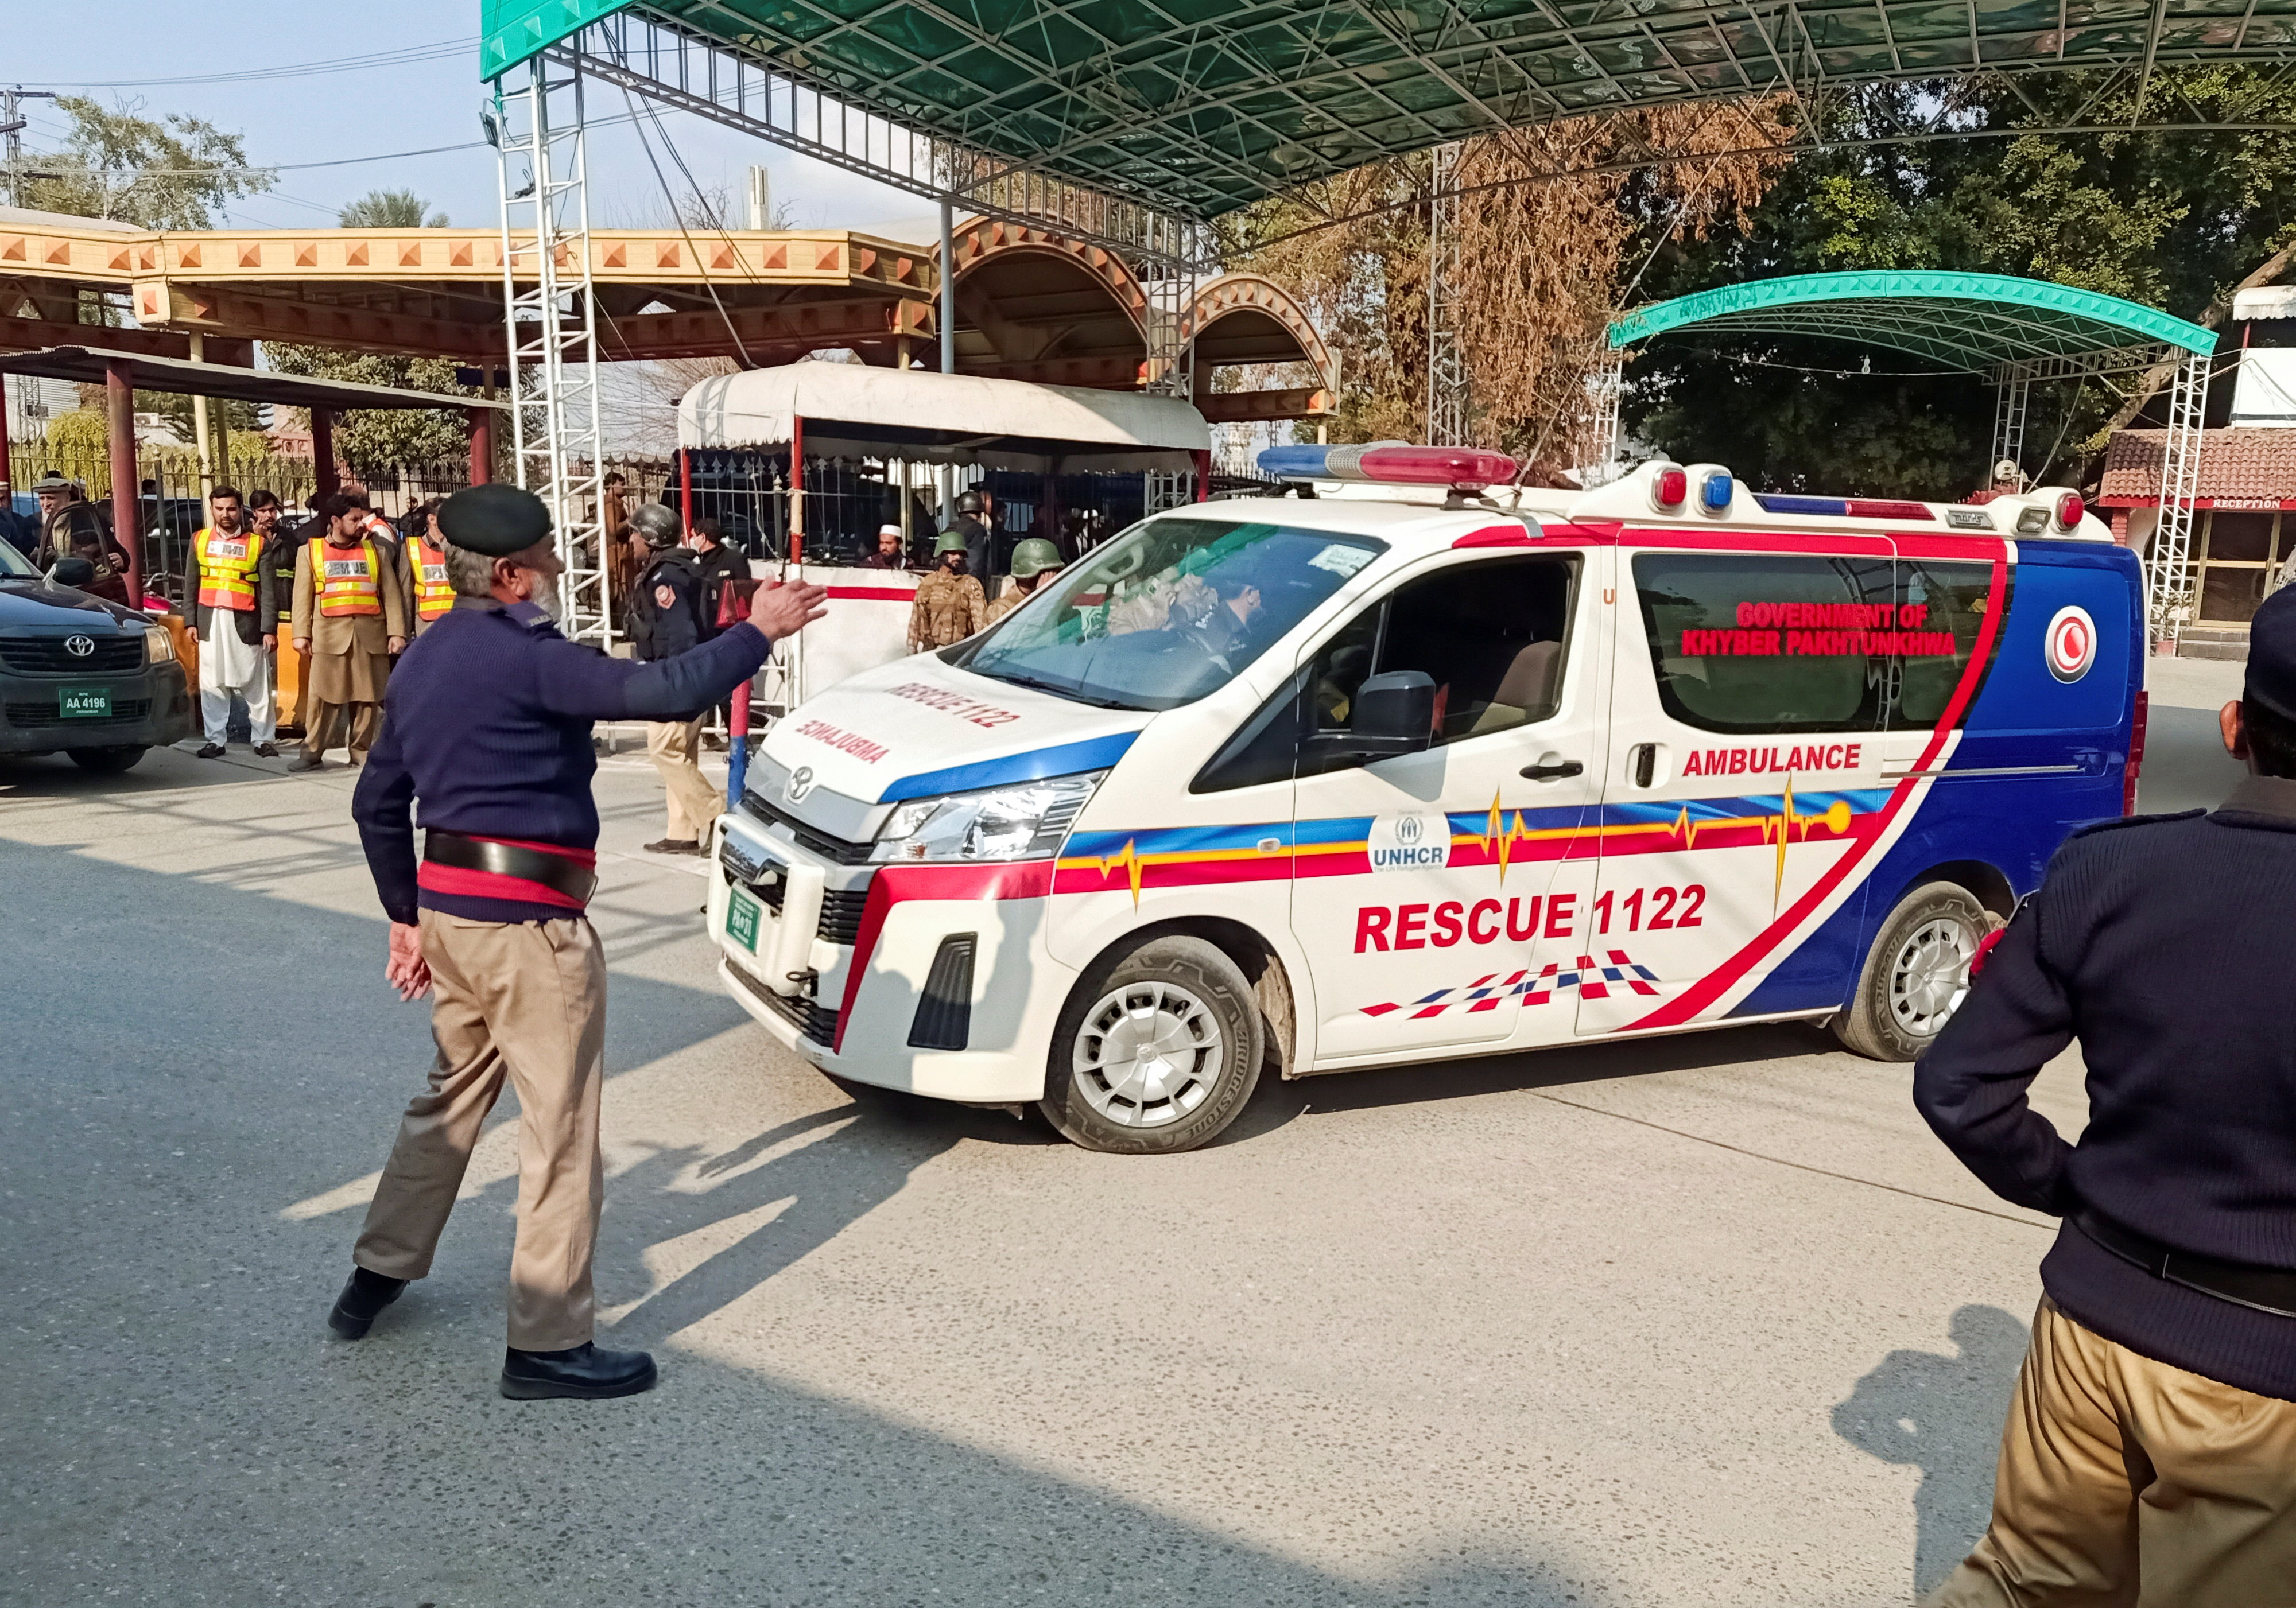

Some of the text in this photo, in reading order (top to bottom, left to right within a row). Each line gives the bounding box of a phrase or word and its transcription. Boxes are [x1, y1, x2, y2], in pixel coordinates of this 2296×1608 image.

[2213, 499, 2281, 508] RECEPTION
[1736, 601, 1928, 628] GOVERNMENT OF
[1681, 630, 1957, 656] KHYBER PAKHTUNKHWA
[66, 697, 106, 709] AA 4196
[883, 682, 1021, 729] RESCUE 1122
[1682, 744, 1861, 776] AMBULANCE
[1374, 846, 1443, 866] UNHCR
[1353, 884, 1706, 954] RESCUE 1122
